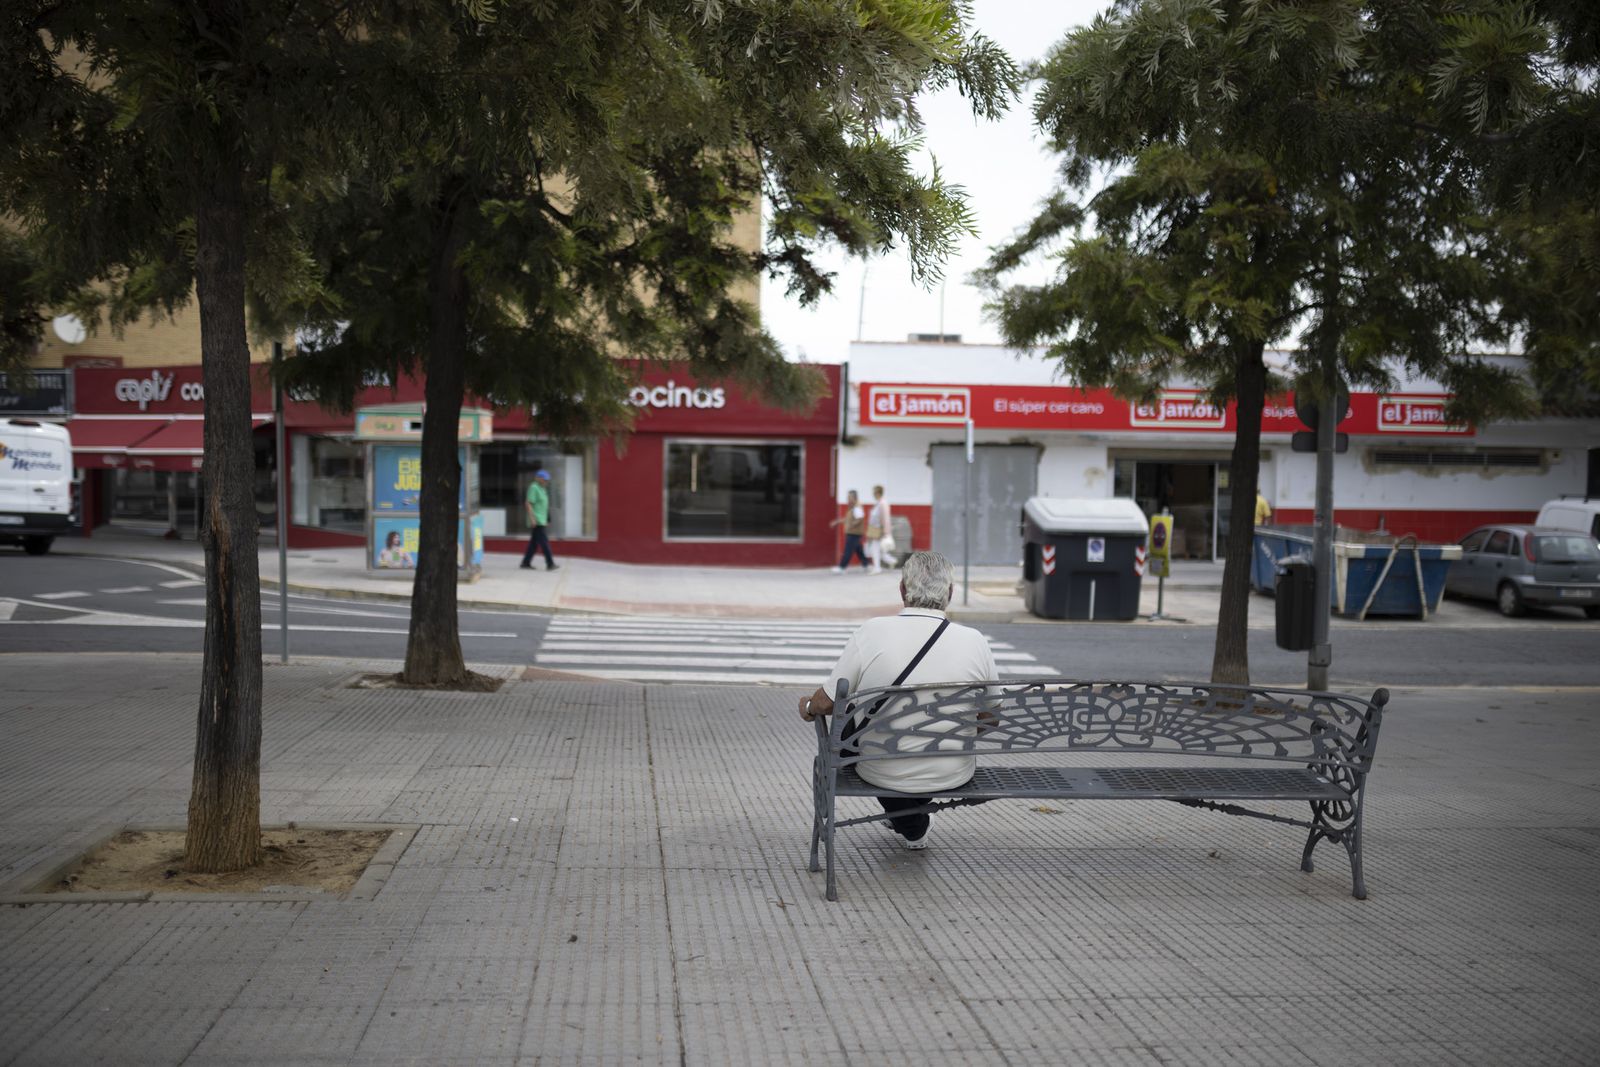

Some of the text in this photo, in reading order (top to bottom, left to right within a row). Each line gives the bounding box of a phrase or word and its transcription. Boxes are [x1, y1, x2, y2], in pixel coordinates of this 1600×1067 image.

[876, 391, 963, 416] el jamón
[994, 398, 1007, 412] El
[1008, 399, 1046, 415] súper
[1384, 402, 1446, 425] el jam
